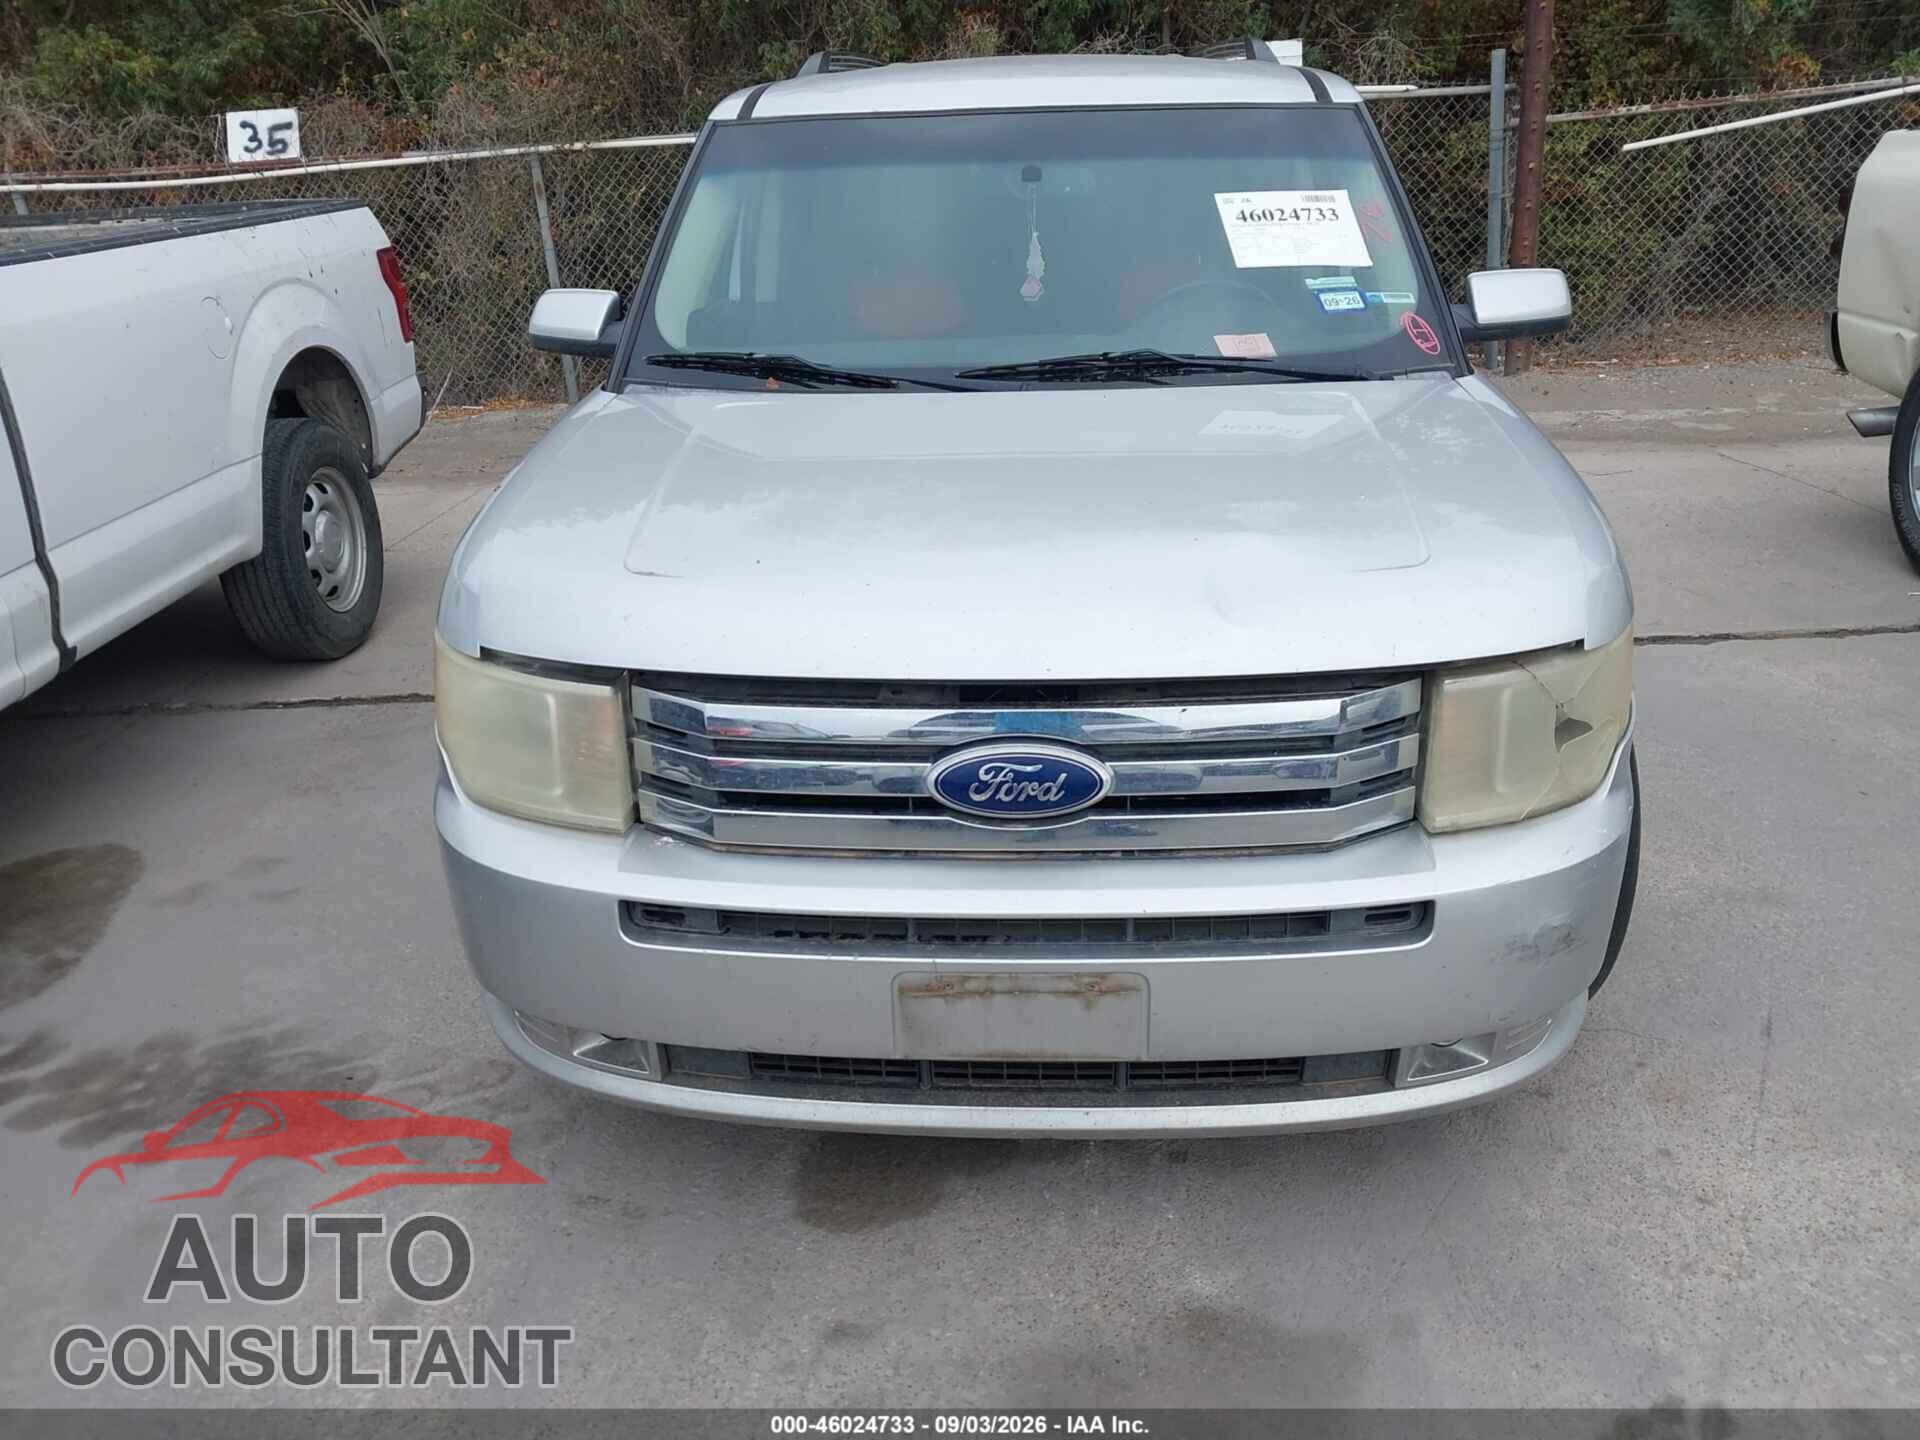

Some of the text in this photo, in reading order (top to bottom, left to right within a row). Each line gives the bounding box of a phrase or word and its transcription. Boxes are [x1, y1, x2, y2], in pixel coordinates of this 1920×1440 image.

[239, 120, 294, 156] 35
[1235, 207, 1340, 223] 46024733
[968, 762, 1068, 802] Ford
